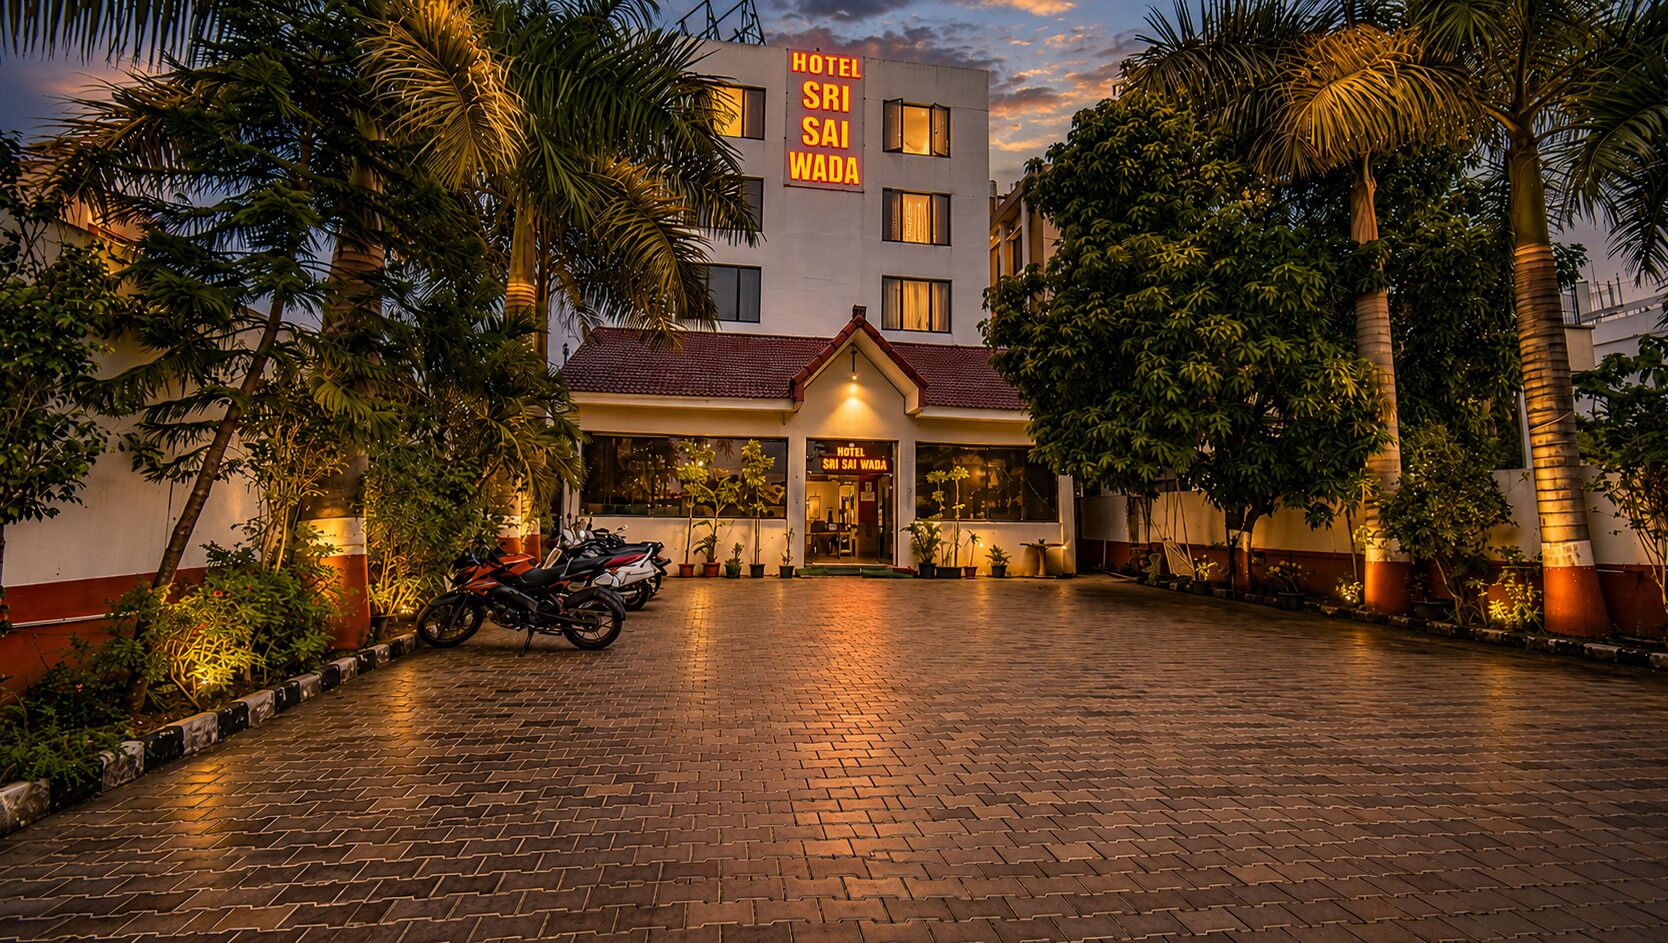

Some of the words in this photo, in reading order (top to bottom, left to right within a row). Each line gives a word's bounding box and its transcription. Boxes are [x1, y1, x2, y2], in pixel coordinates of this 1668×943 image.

[792, 52, 861, 78] HOTEL
[802, 80, 850, 112] SRI
[802, 116, 849, 149] SAI
[789, 151, 860, 185] WADA
[822, 458, 839, 470] SRI
[841, 459, 857, 470] SAI
[860, 459, 887, 470] WADA
[837, 447, 865, 457] HOTEL
